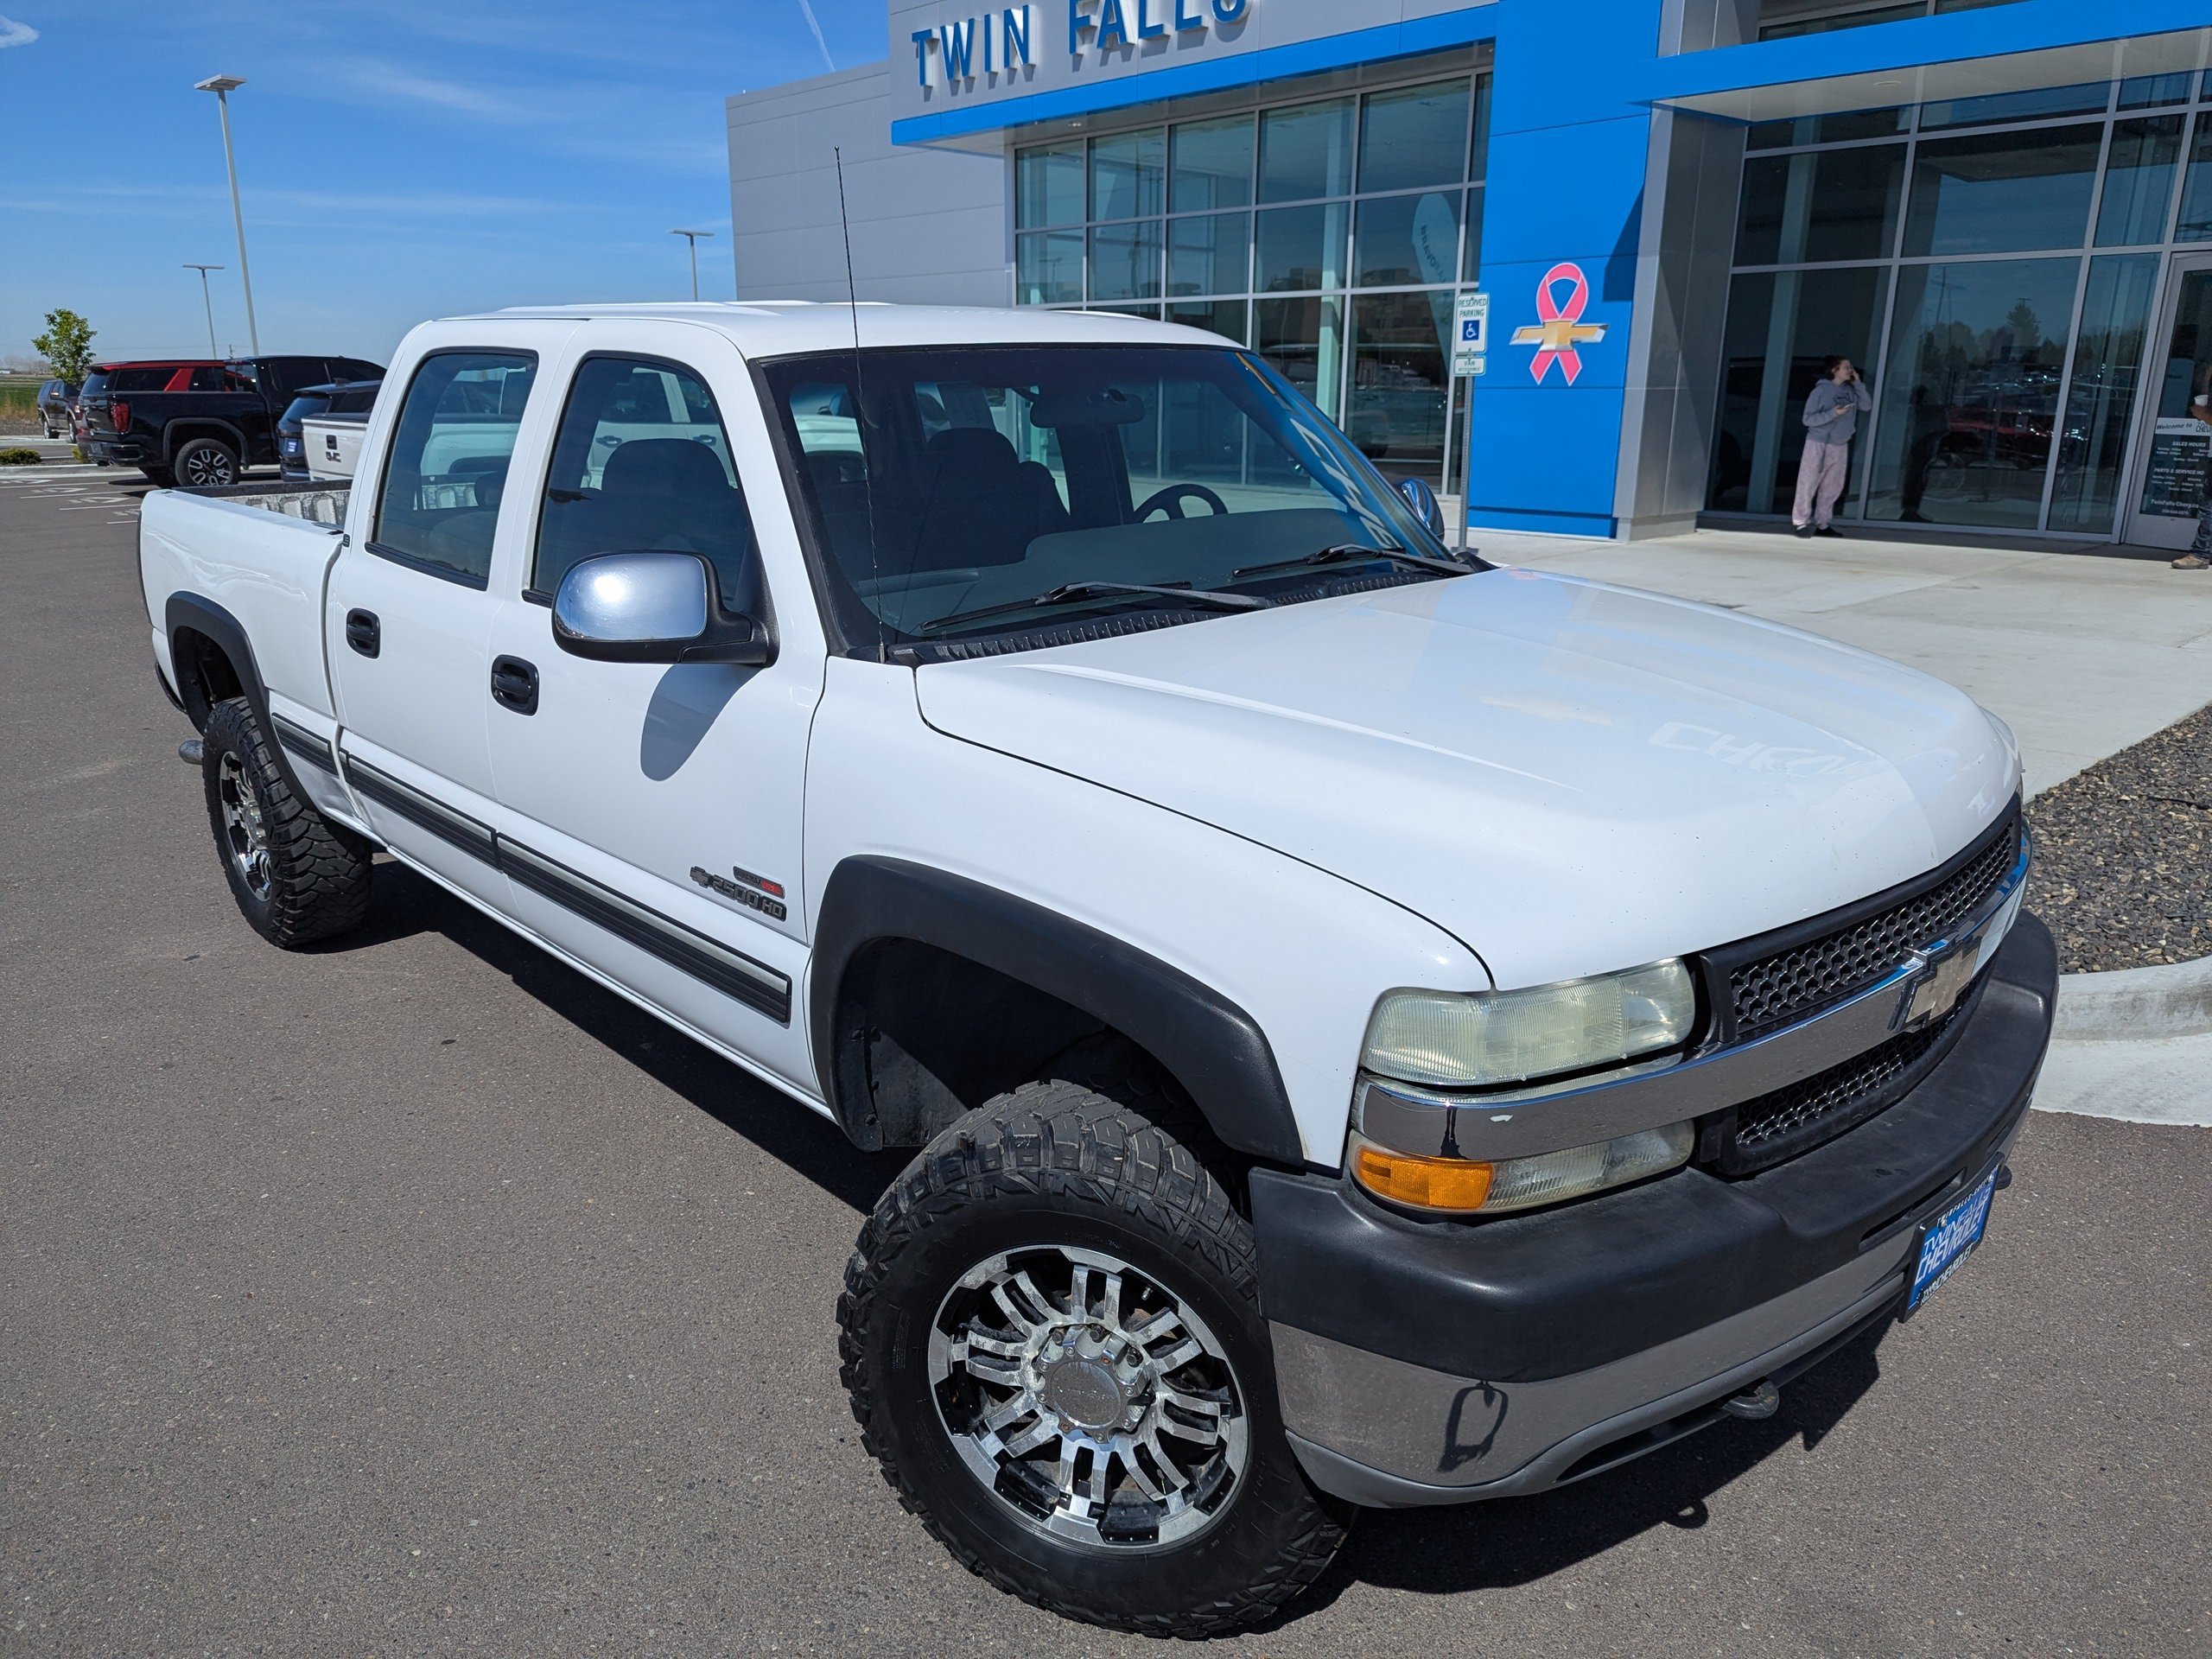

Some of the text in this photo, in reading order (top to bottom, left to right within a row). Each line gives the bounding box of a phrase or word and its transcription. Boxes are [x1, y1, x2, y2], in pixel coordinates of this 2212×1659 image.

[912, 4, 1033, 86] TWIN
[1458, 298, 1487, 308] RESERVED
[1459, 308, 1484, 318] PARKING
[326, 451, 341, 463] GMC
[713, 874, 761, 912] 2500
[761, 896, 785, 920] HD
[1914, 1200, 1986, 1285] CHEVROLET
[1936, 1246, 1973, 1289] CHEVROLET
